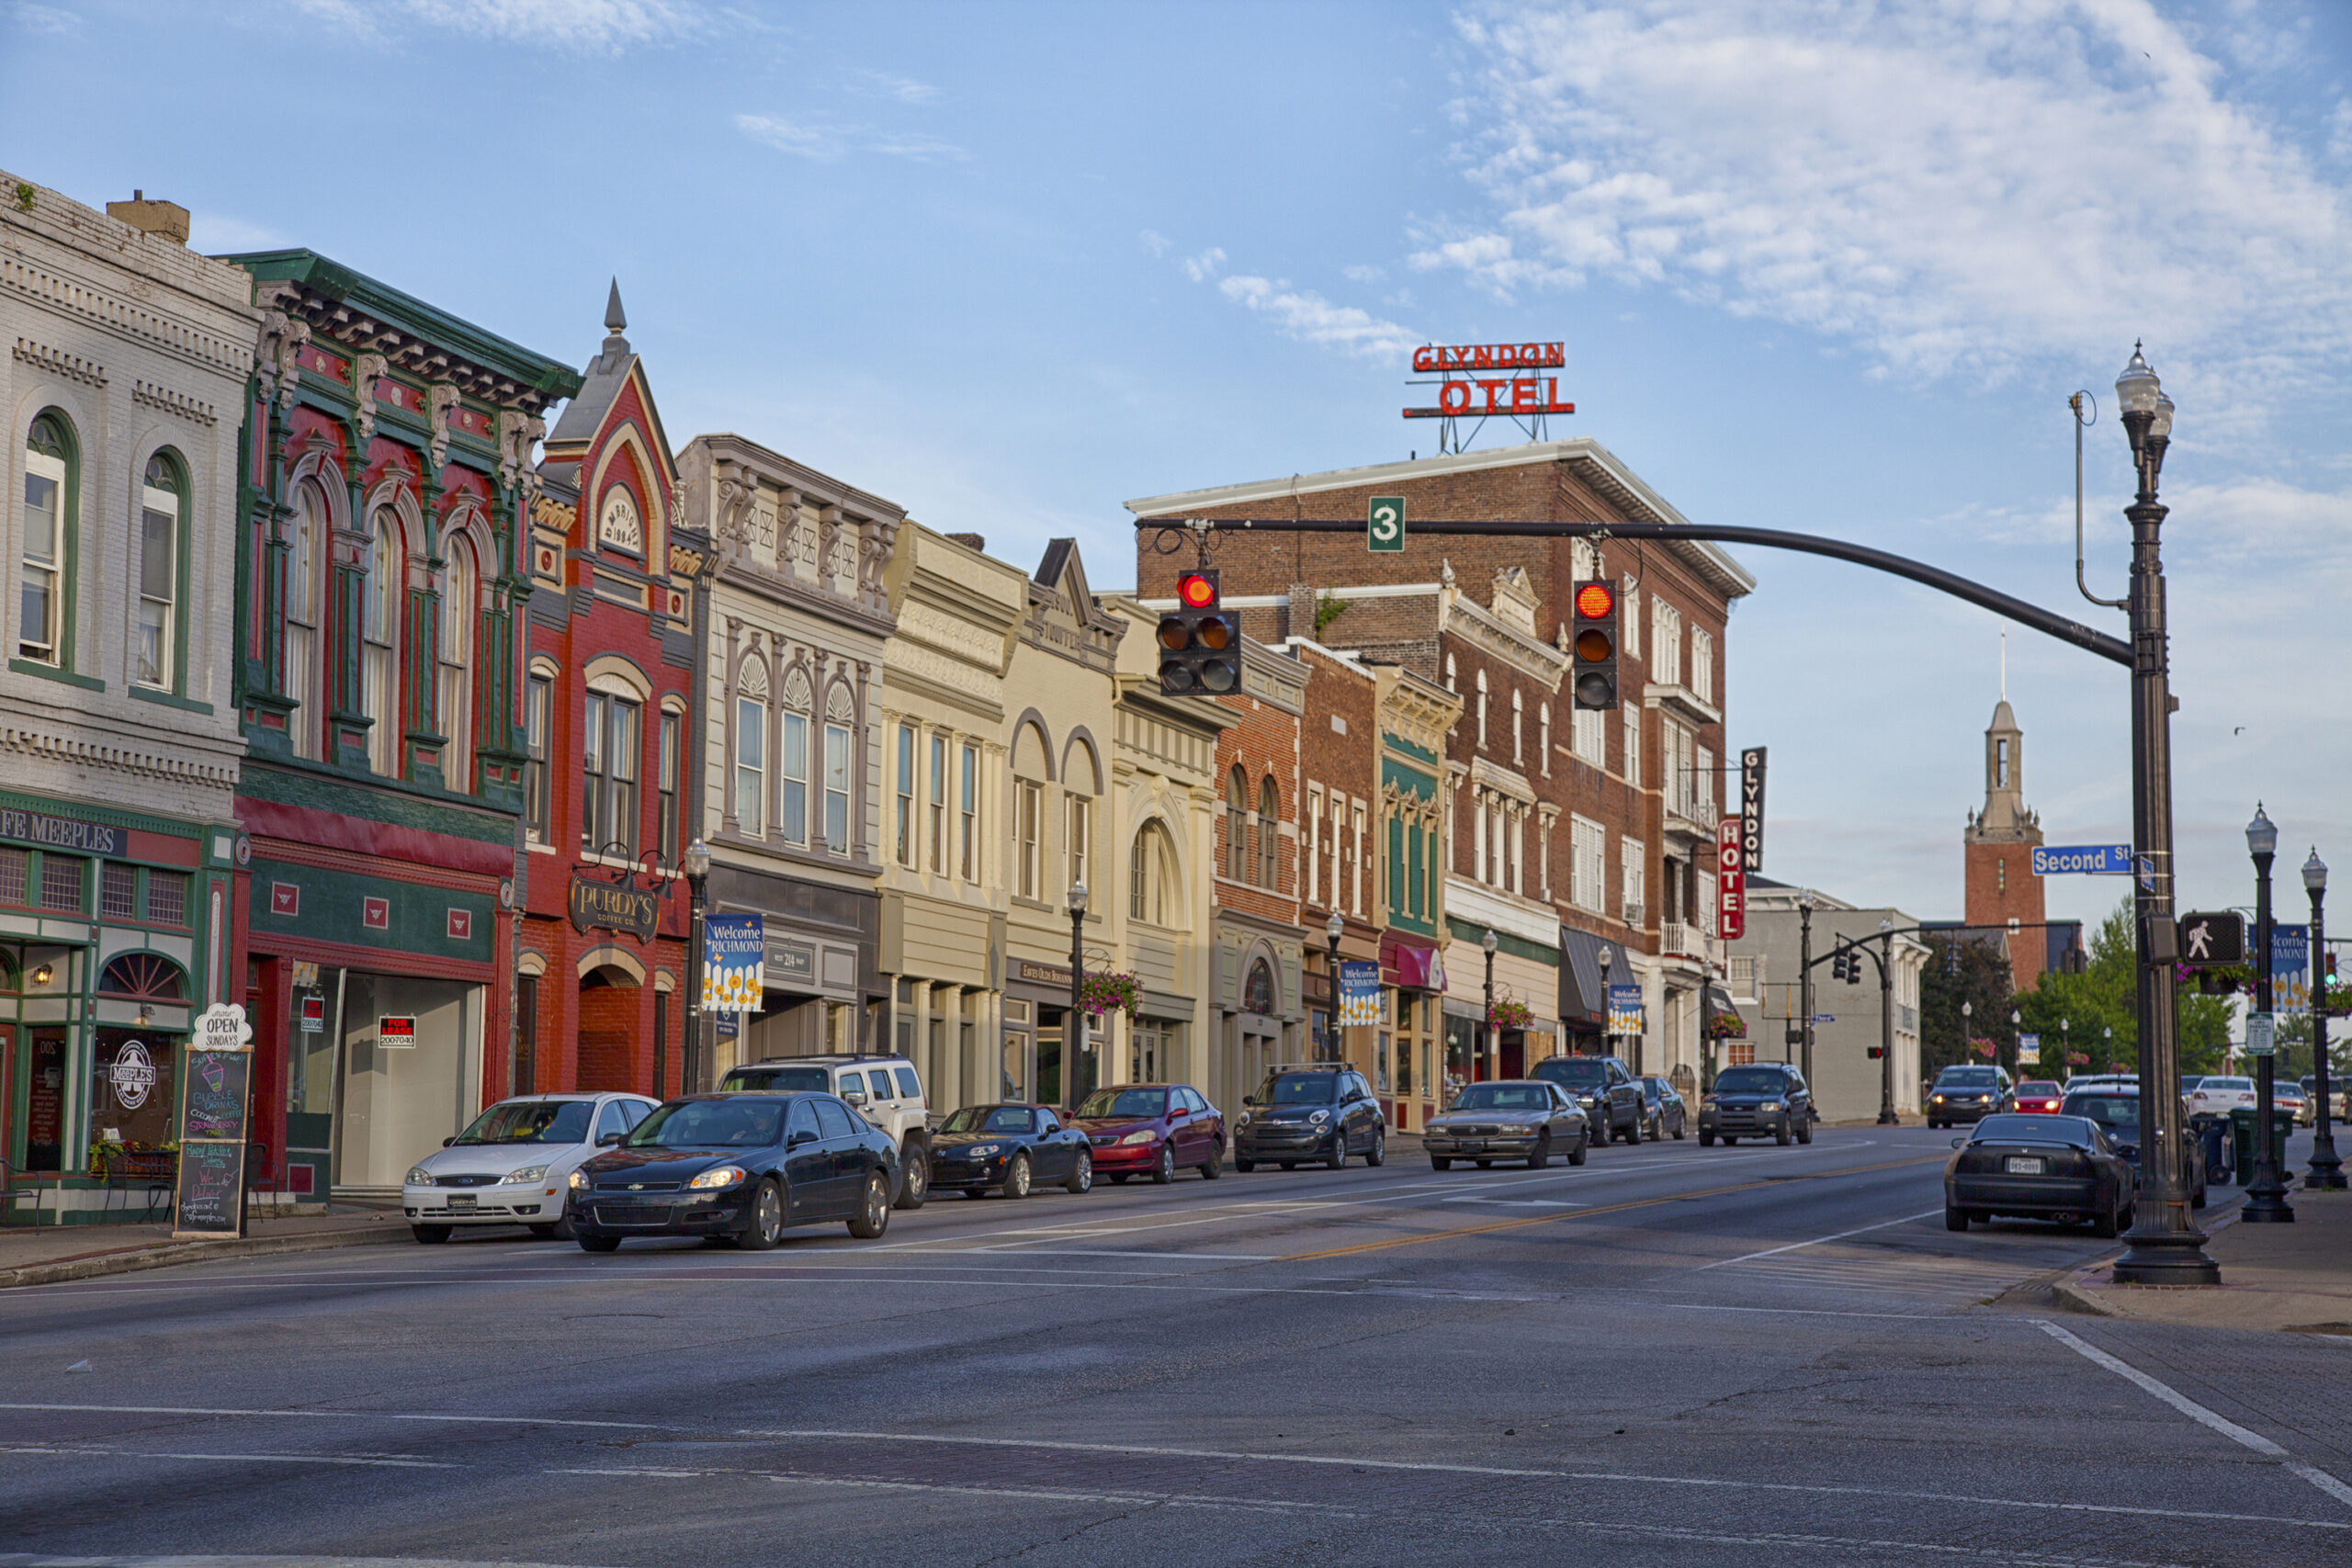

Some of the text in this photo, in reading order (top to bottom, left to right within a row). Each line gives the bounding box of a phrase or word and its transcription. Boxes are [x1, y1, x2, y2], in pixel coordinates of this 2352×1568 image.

[1413, 342, 1564, 371] GLYNDON
[1373, 506, 1397, 541] 3
[1744, 750, 1759, 869] GLYNDON
[0, 809, 114, 852] FE MEEPLES
[2035, 846, 2130, 872] Second St
[1722, 826, 1739, 933] HOTEL
[580, 886, 652, 925] PURDY'S
[597, 913, 636, 927] COFFEE CO.
[714, 925, 761, 940] Welcome
[712, 940, 763, 953] RICHMOND
[784, 953, 795, 967] 214
[1345, 968, 1378, 979] Welcome
[1343, 978, 1379, 987] RICHMOND
[207, 1018, 239, 1033] OPEN
[388, 1019, 407, 1027] FOR
[381, 1027, 413, 1035] LEASE
[206, 1033, 239, 1046] SUNDAYS
[190, 1108, 220, 1123] COCONUT
